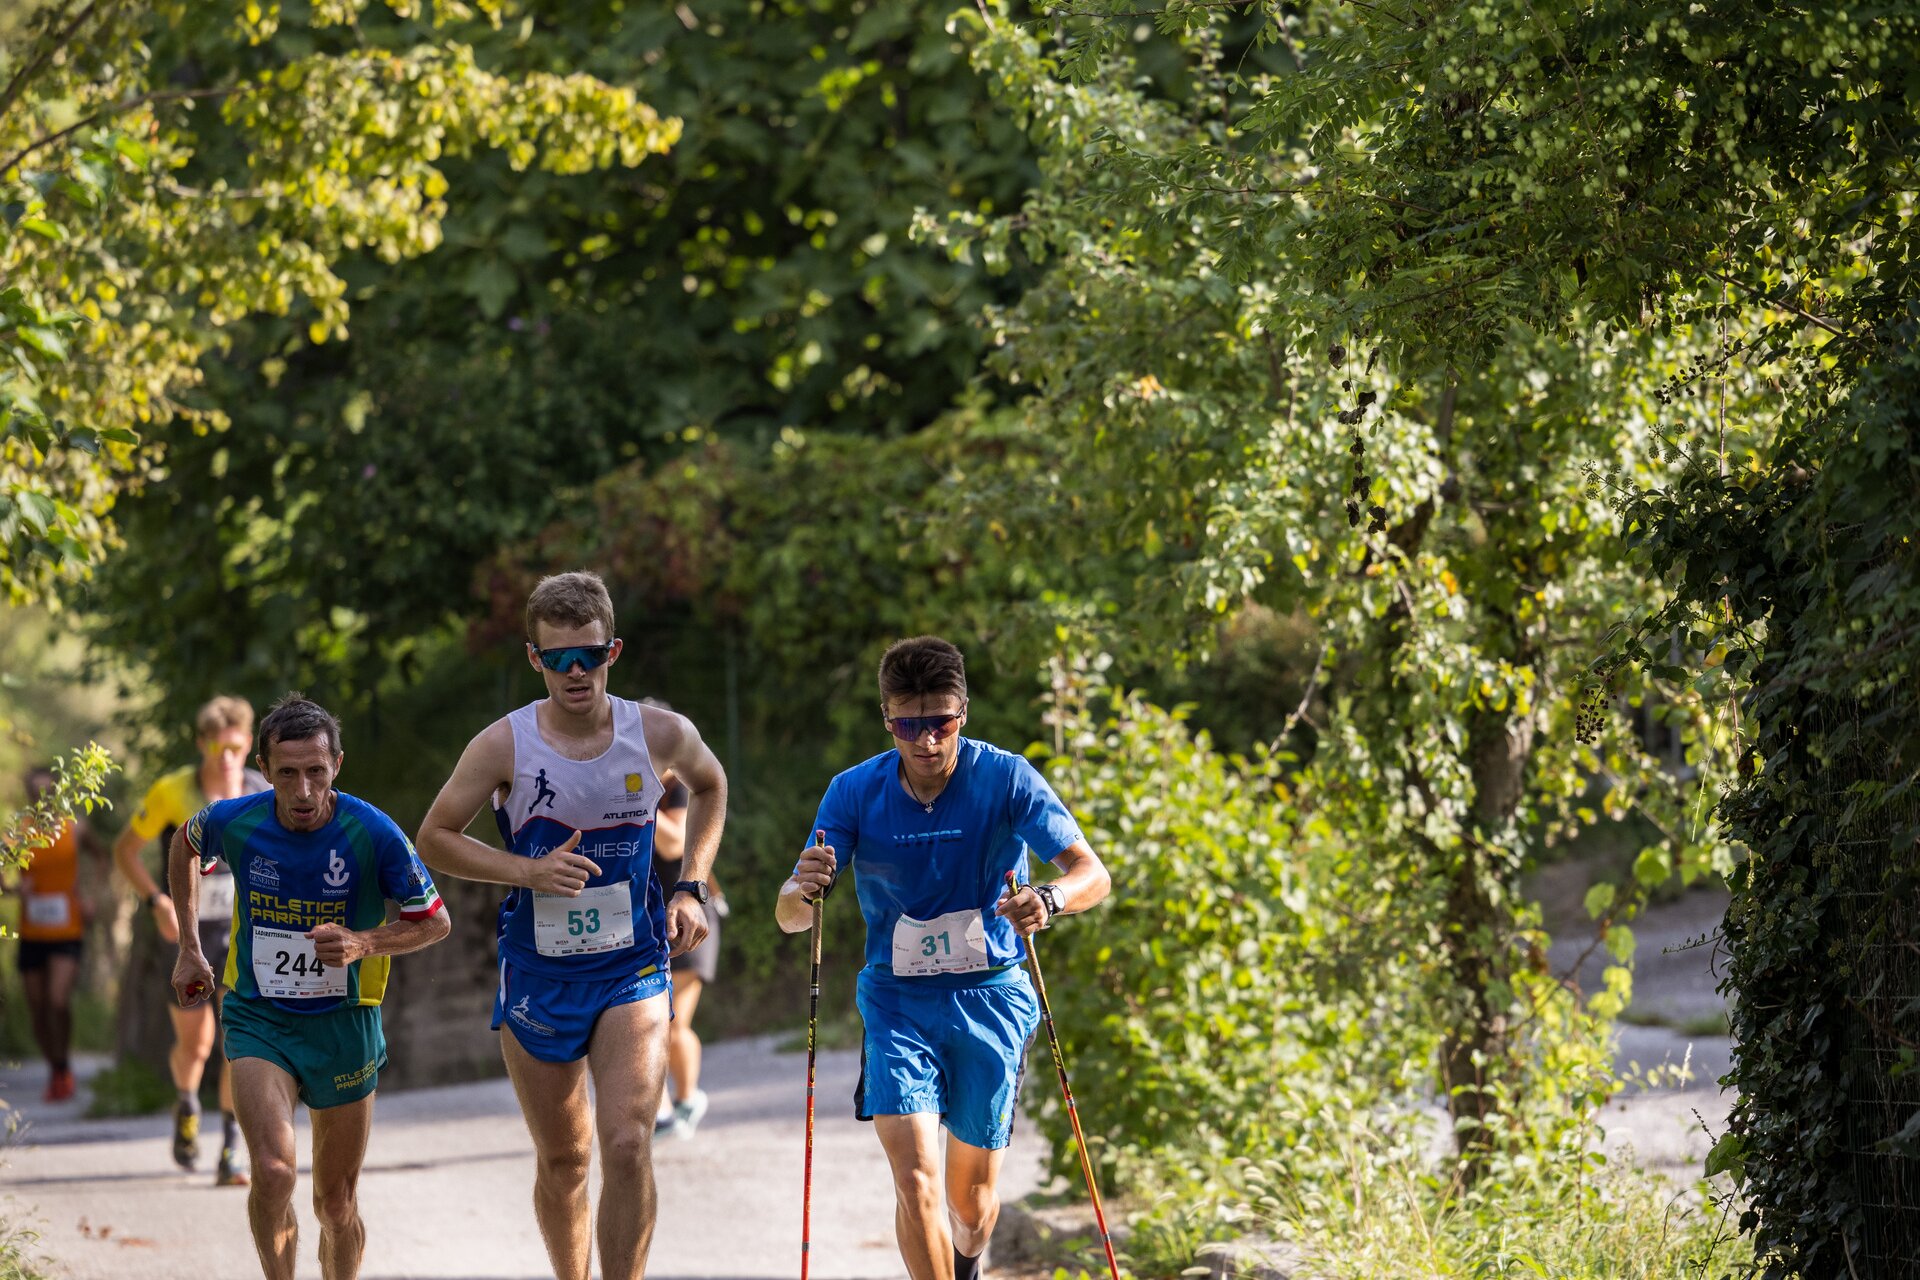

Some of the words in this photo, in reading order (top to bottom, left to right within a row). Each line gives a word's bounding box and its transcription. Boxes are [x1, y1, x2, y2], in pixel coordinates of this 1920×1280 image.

[602, 809, 649, 820] ATLETICA
[530, 841, 639, 858] VAHIESE
[250, 890, 346, 914] ATLETICA
[251, 907, 346, 927] PARATICO
[568, 908, 601, 936] 53
[921, 931, 951, 956] 31
[275, 951, 325, 977] 244
